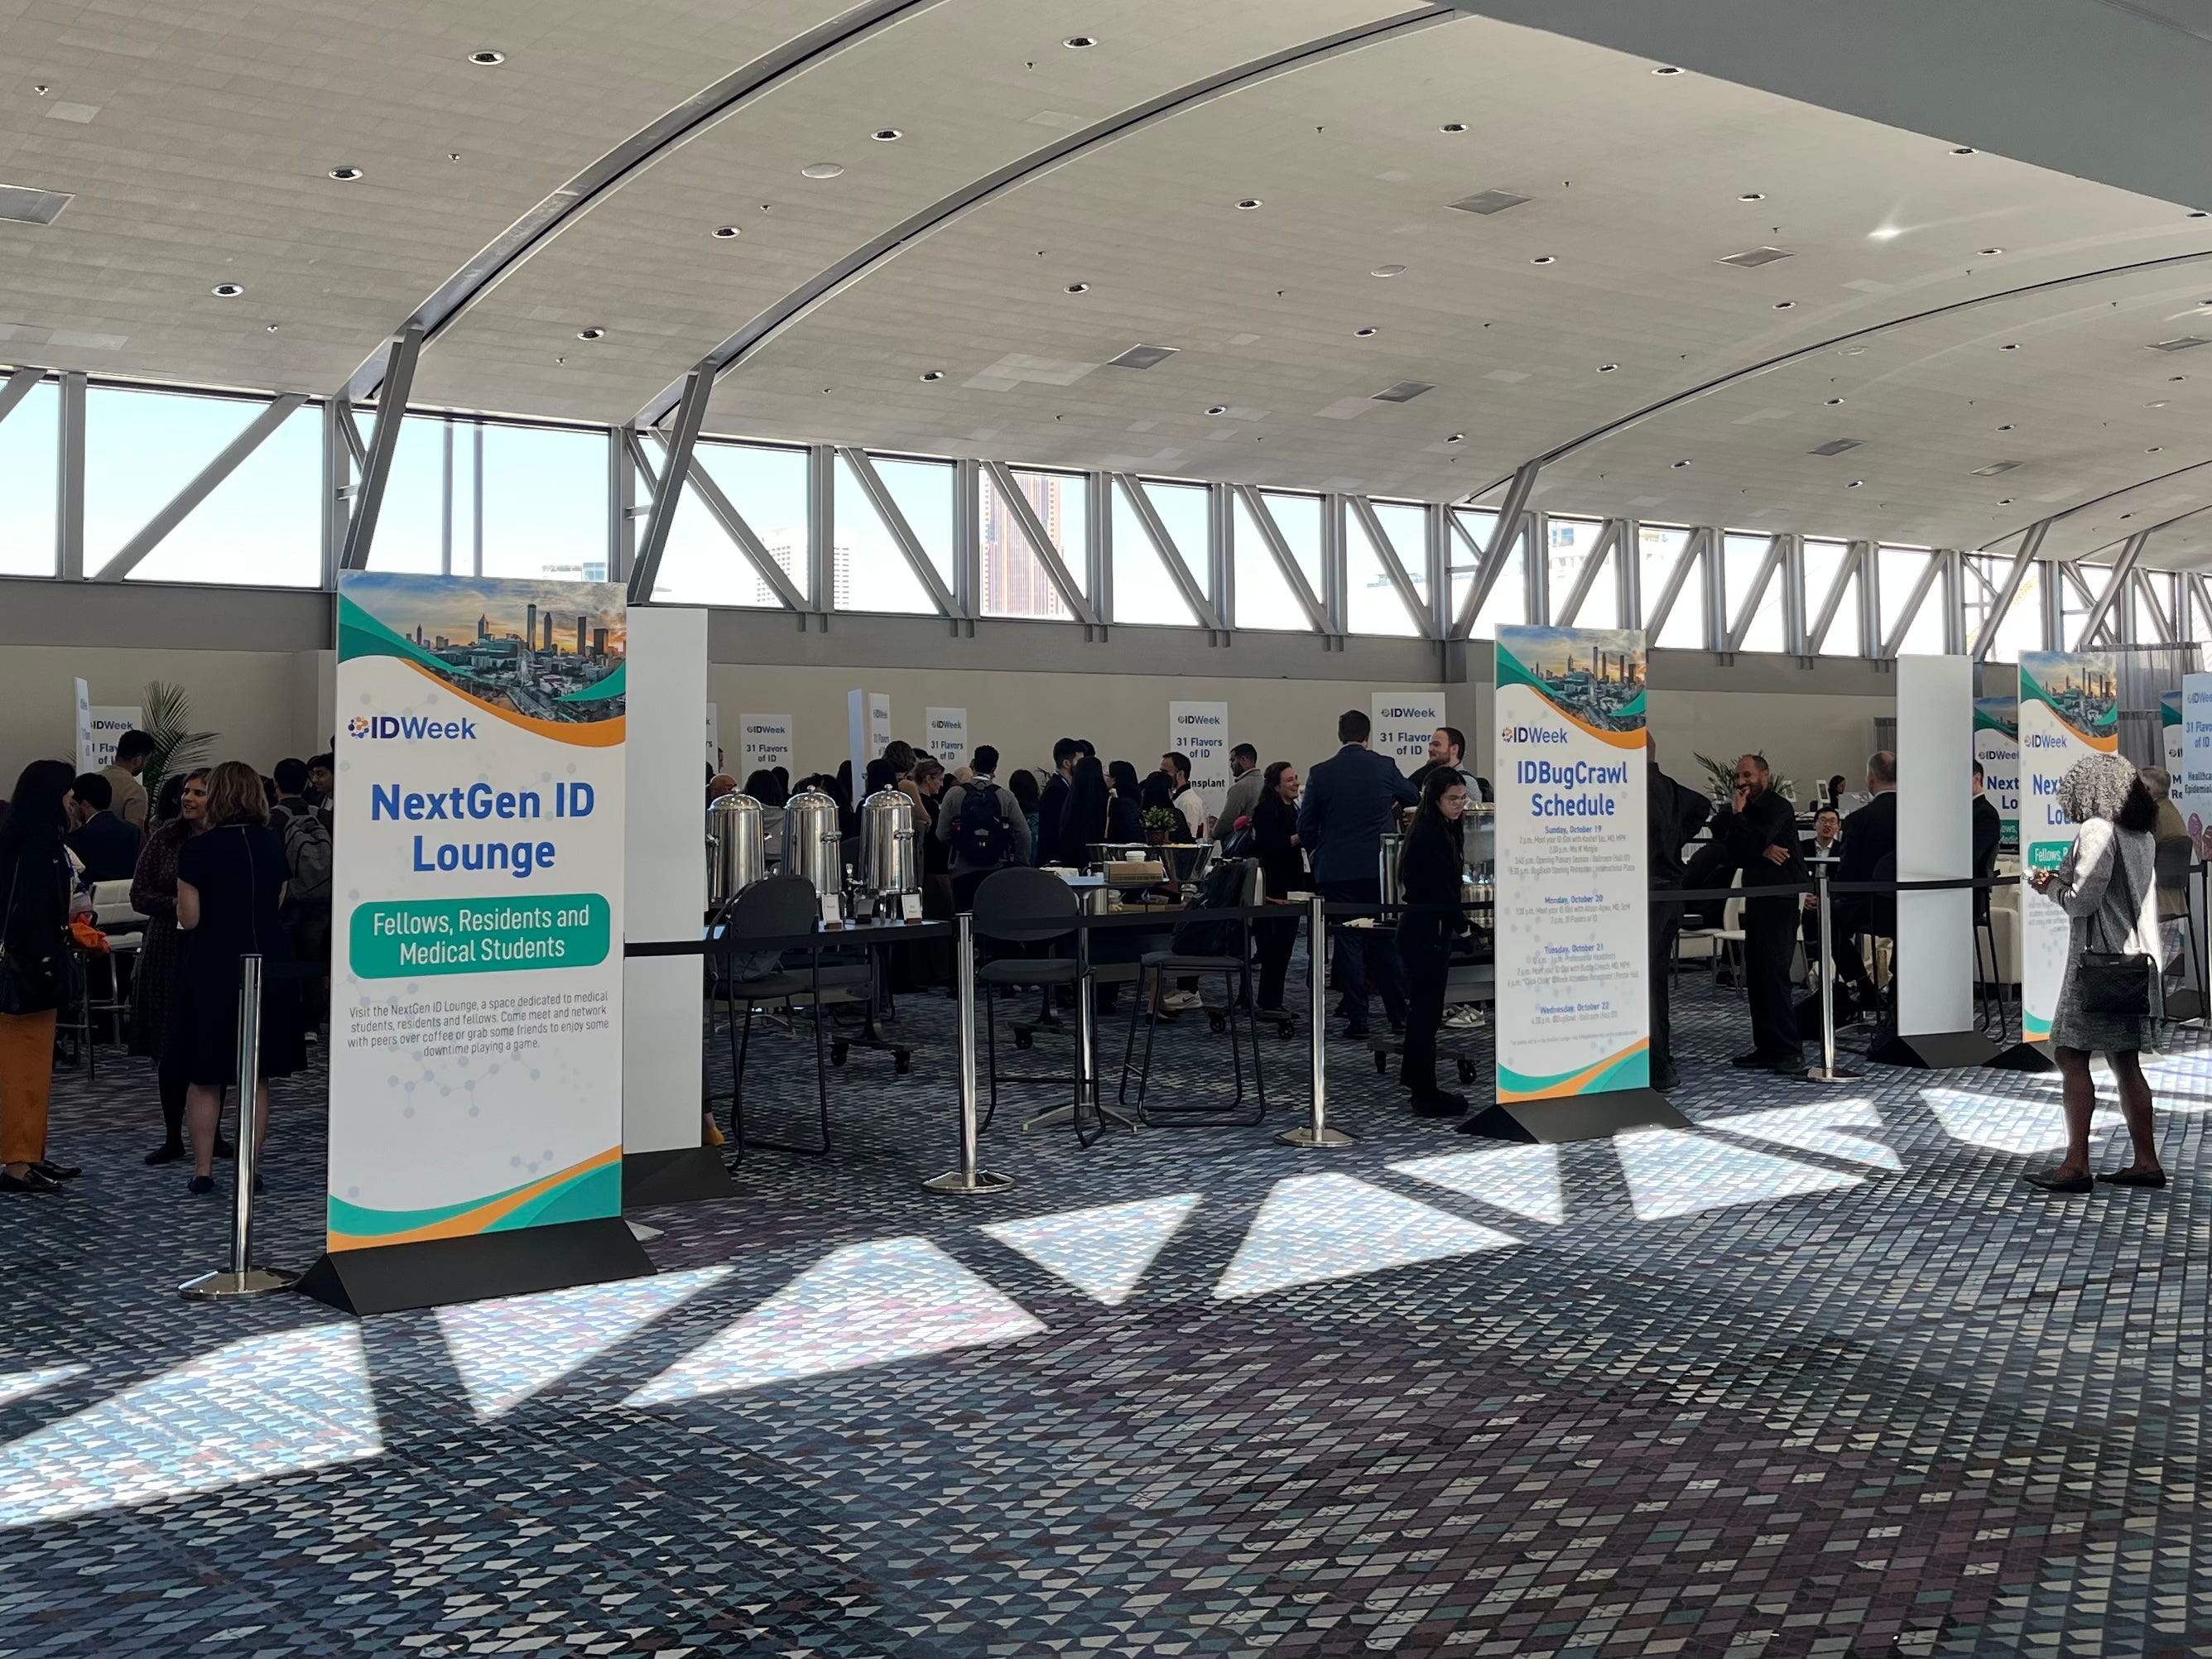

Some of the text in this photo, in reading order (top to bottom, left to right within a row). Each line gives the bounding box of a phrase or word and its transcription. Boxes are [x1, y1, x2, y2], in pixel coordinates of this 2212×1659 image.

[1391, 709, 1435, 717] IDWeek
[94, 721, 132, 729] IDWeek
[1185, 716, 1220, 724] IDWeek
[372, 717, 477, 739] IDWeek
[2186, 722, 2193, 733] 31
[1380, 733, 1392, 742] 31
[1514, 727, 1568, 743] IDWeek
[941, 741, 964, 749] Flavors
[1177, 738, 1223, 746] 31 Flavors
[2032, 735, 2067, 748] IDWeek
[2203, 737, 2210, 748] ID
[1397, 746, 1422, 754] of ID
[99, 756, 107, 764] of
[1517, 761, 1628, 789] IDBugCrawl
[372, 783, 594, 820] NextGen ID
[1532, 793, 1614, 816] Schedule
[1595, 825, 1602, 833] 19
[414, 835, 555, 878] Lounge
[1545, 897, 1569, 905] Monday,
[1595, 894, 1604, 902] 20
[374, 904, 589, 935] Fellows, Residents and
[401, 937, 565, 965] Medical Students
[1544, 945, 1570, 954] Tuesday,
[349, 991, 608, 1017] Visit the NextGen ID Lounge, a space dedicated to medical
[1540, 1005, 1575, 1014] Wednesday,
[351, 1005, 606, 1033] students, residents and fellows. Come meet and network
[349, 1020, 608, 1048] with peers over coffee or grab some friends to enjoy some
[424, 1040, 540, 1057] downtime playing a game.
